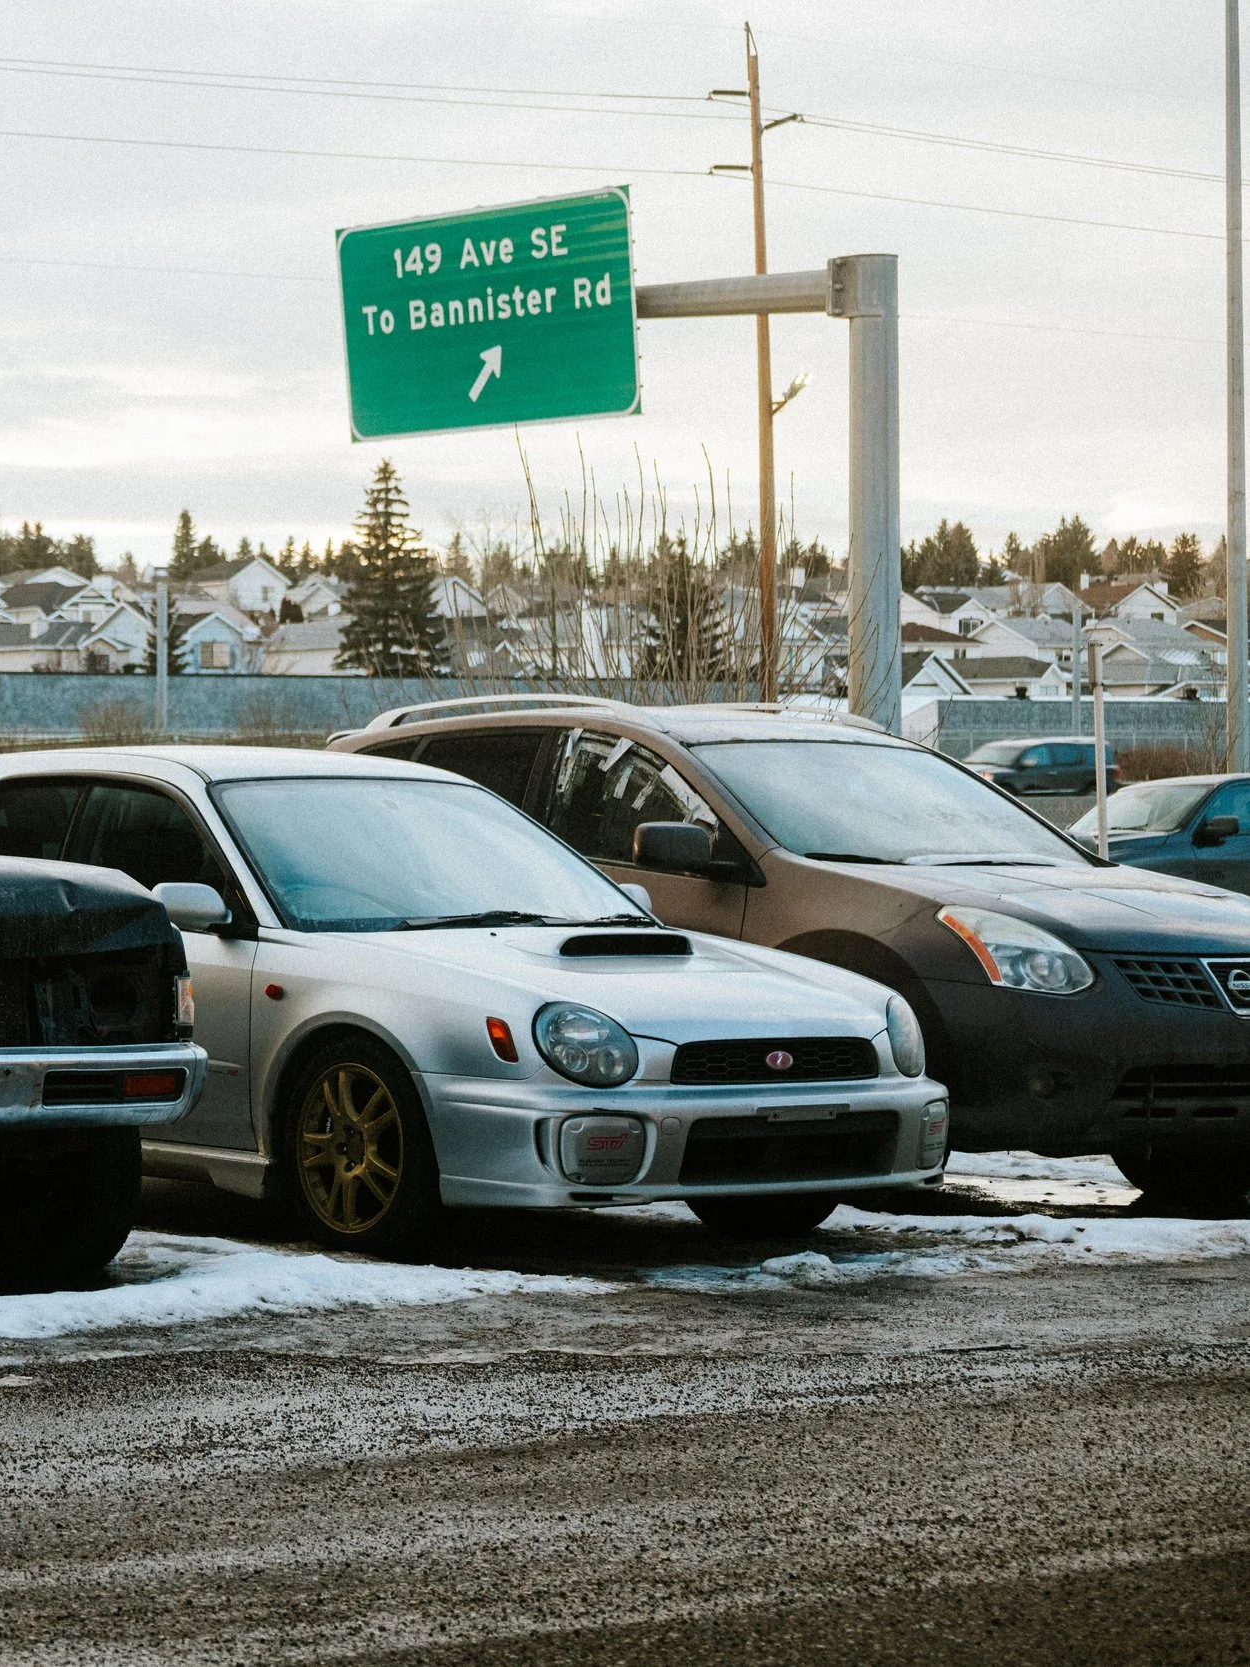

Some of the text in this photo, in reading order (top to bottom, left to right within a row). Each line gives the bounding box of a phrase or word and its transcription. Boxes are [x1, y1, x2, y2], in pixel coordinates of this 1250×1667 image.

[393, 224, 568, 278] 149 Ave SE
[362, 272, 612, 336] To Bannister Rd
